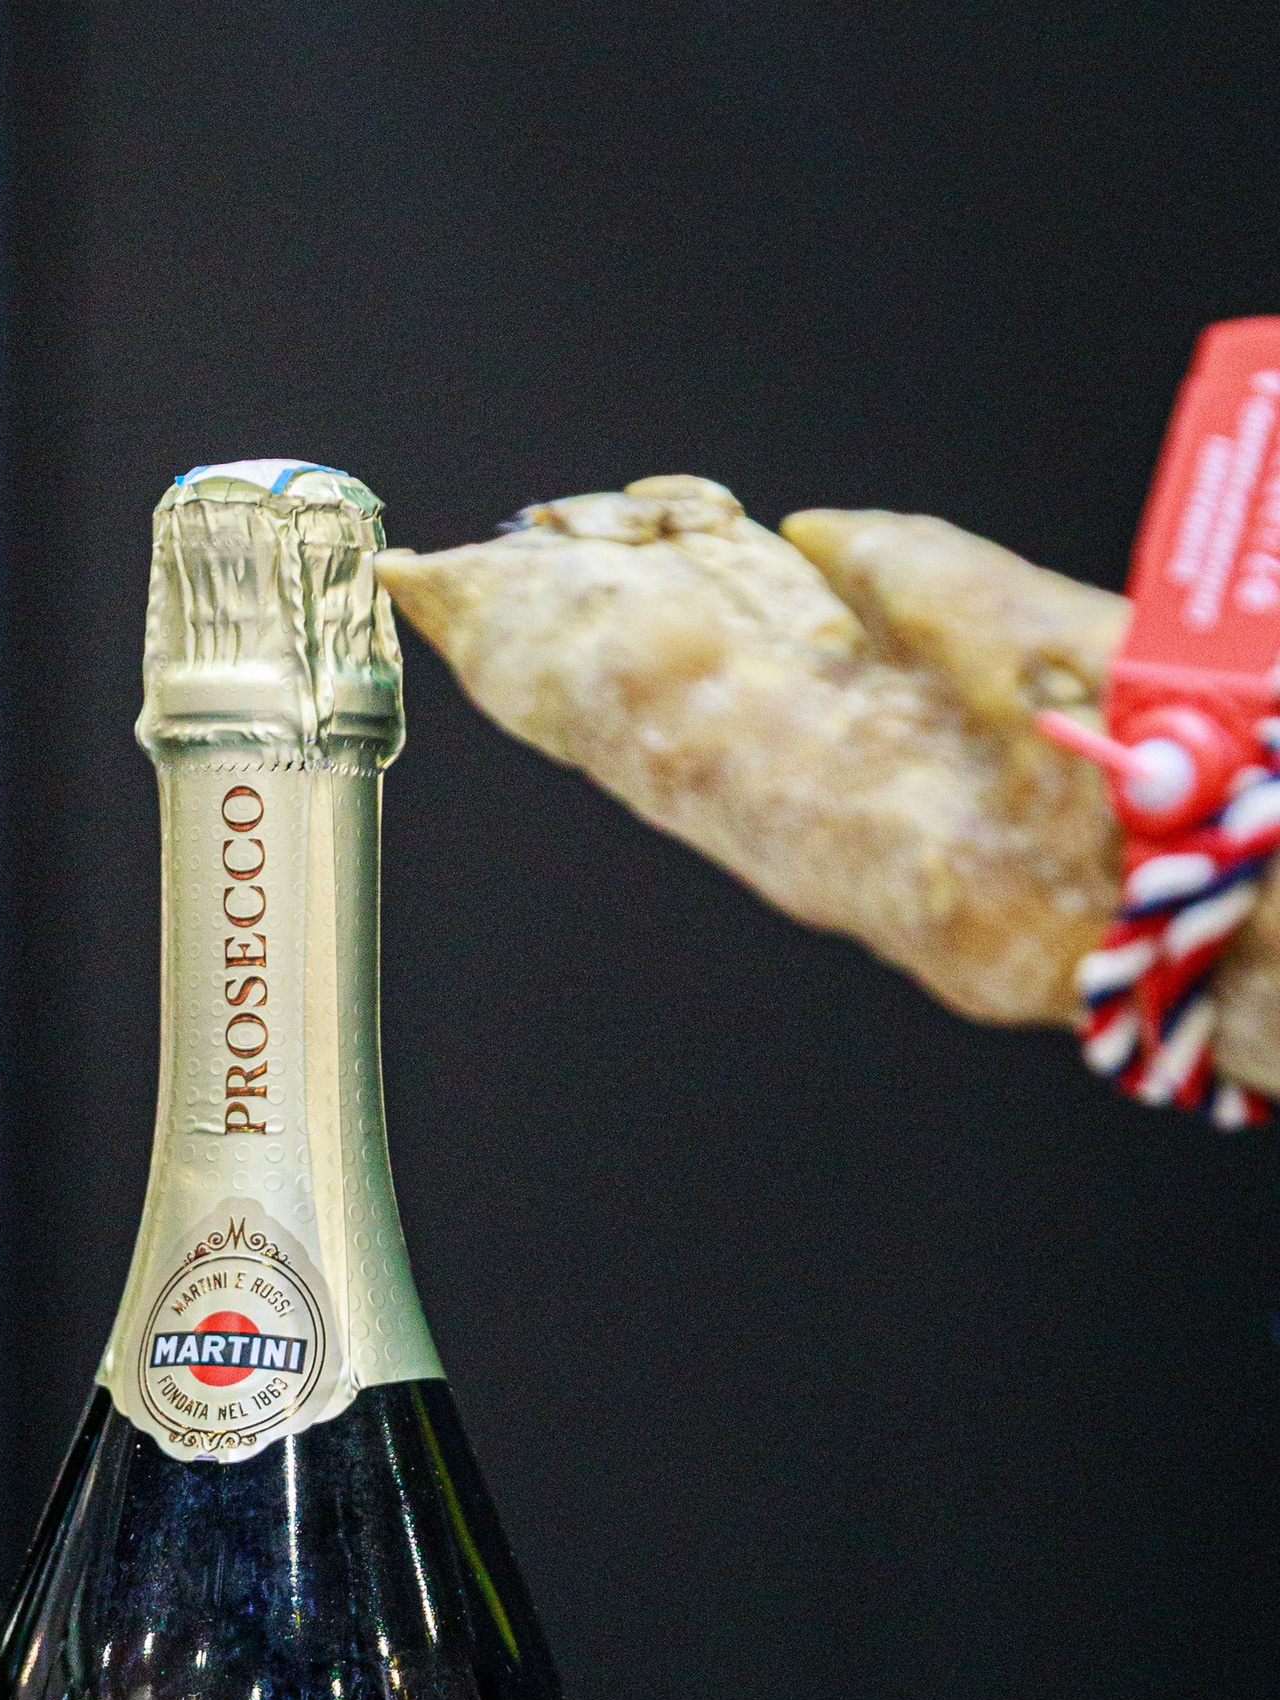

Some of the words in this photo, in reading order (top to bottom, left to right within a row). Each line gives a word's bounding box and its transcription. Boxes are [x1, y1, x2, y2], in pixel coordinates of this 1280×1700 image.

[221, 785, 268, 1135] PROSECCO
[171, 1271, 227, 1316] MARTINI
[235, 1271, 246, 1289] E
[250, 1276, 295, 1317] ROSSI
[152, 1334, 301, 1370] MARTINI
[157, 1374, 209, 1420] FONDATA
[217, 1401, 248, 1420] NEL
[251, 1376, 289, 1410] 1863
